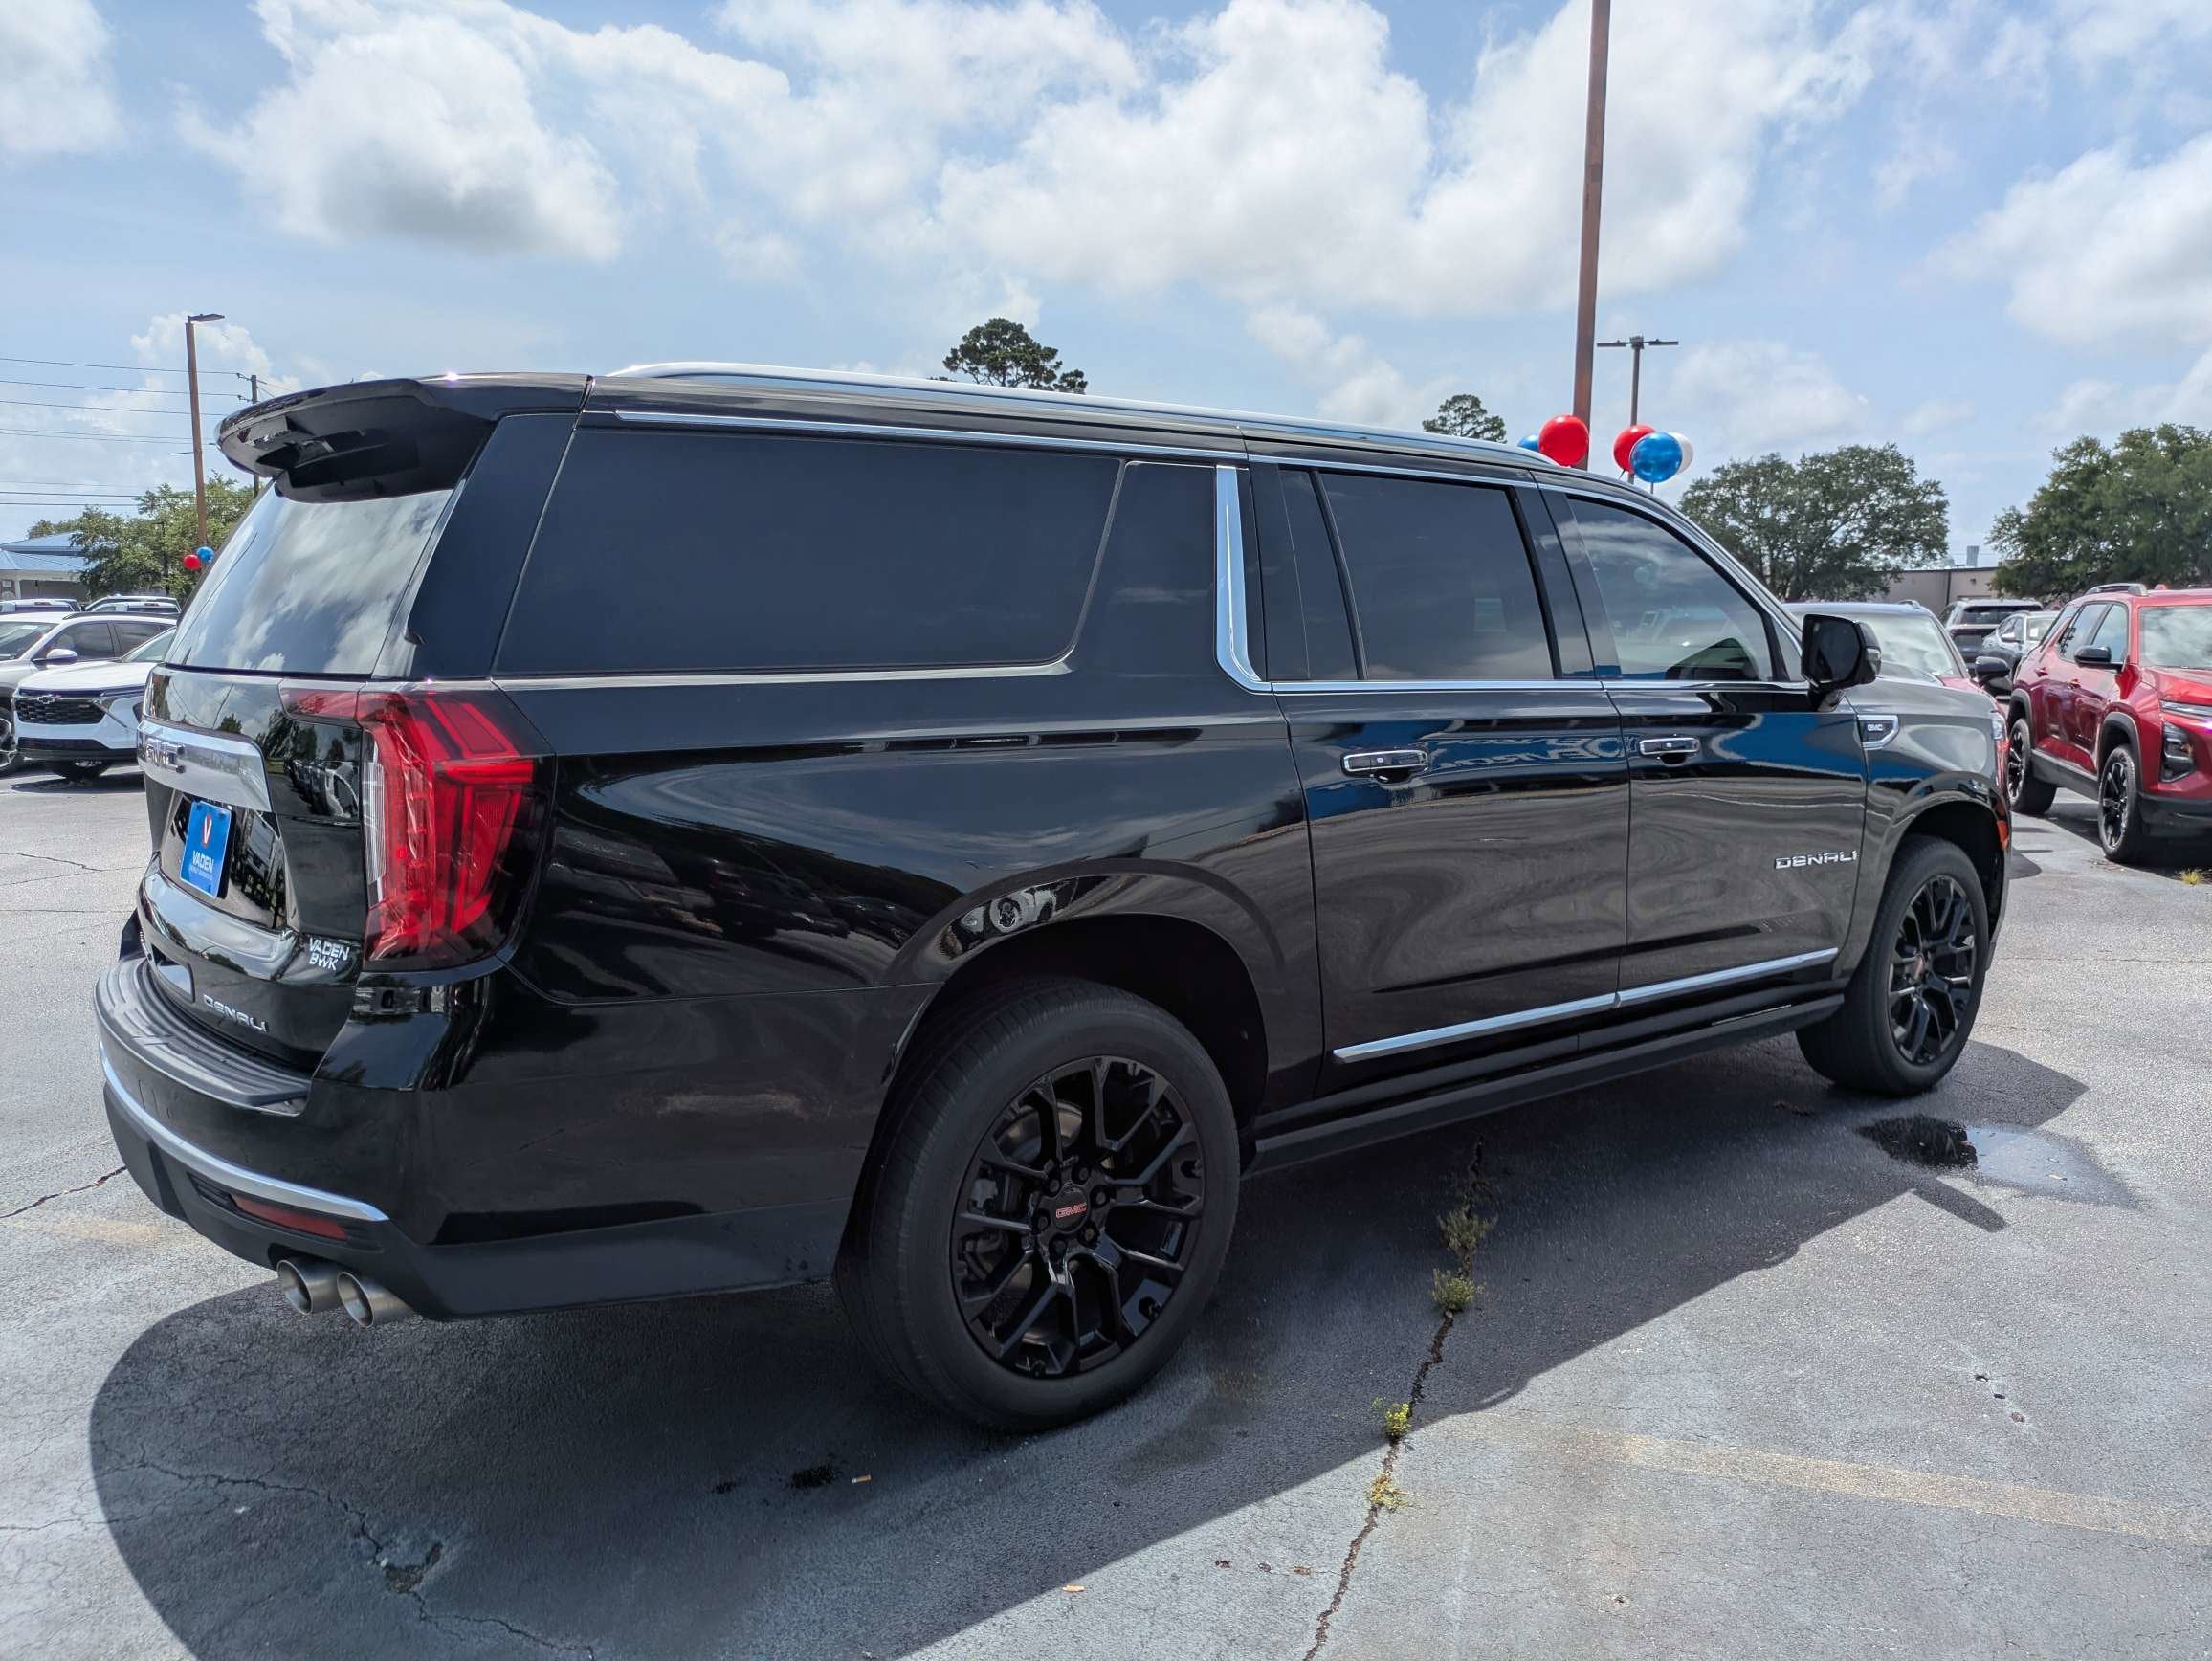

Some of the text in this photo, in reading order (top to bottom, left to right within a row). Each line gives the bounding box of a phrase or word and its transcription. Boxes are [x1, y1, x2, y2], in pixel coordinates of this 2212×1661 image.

[192, 850, 215, 874] VADEN
[1775, 850, 1858, 870] DENALI
[309, 937, 350, 961] VADEN
[309, 951, 337, 971] BWK
[203, 994, 267, 1033] DENALI
[1055, 1202, 1087, 1219] GMC
